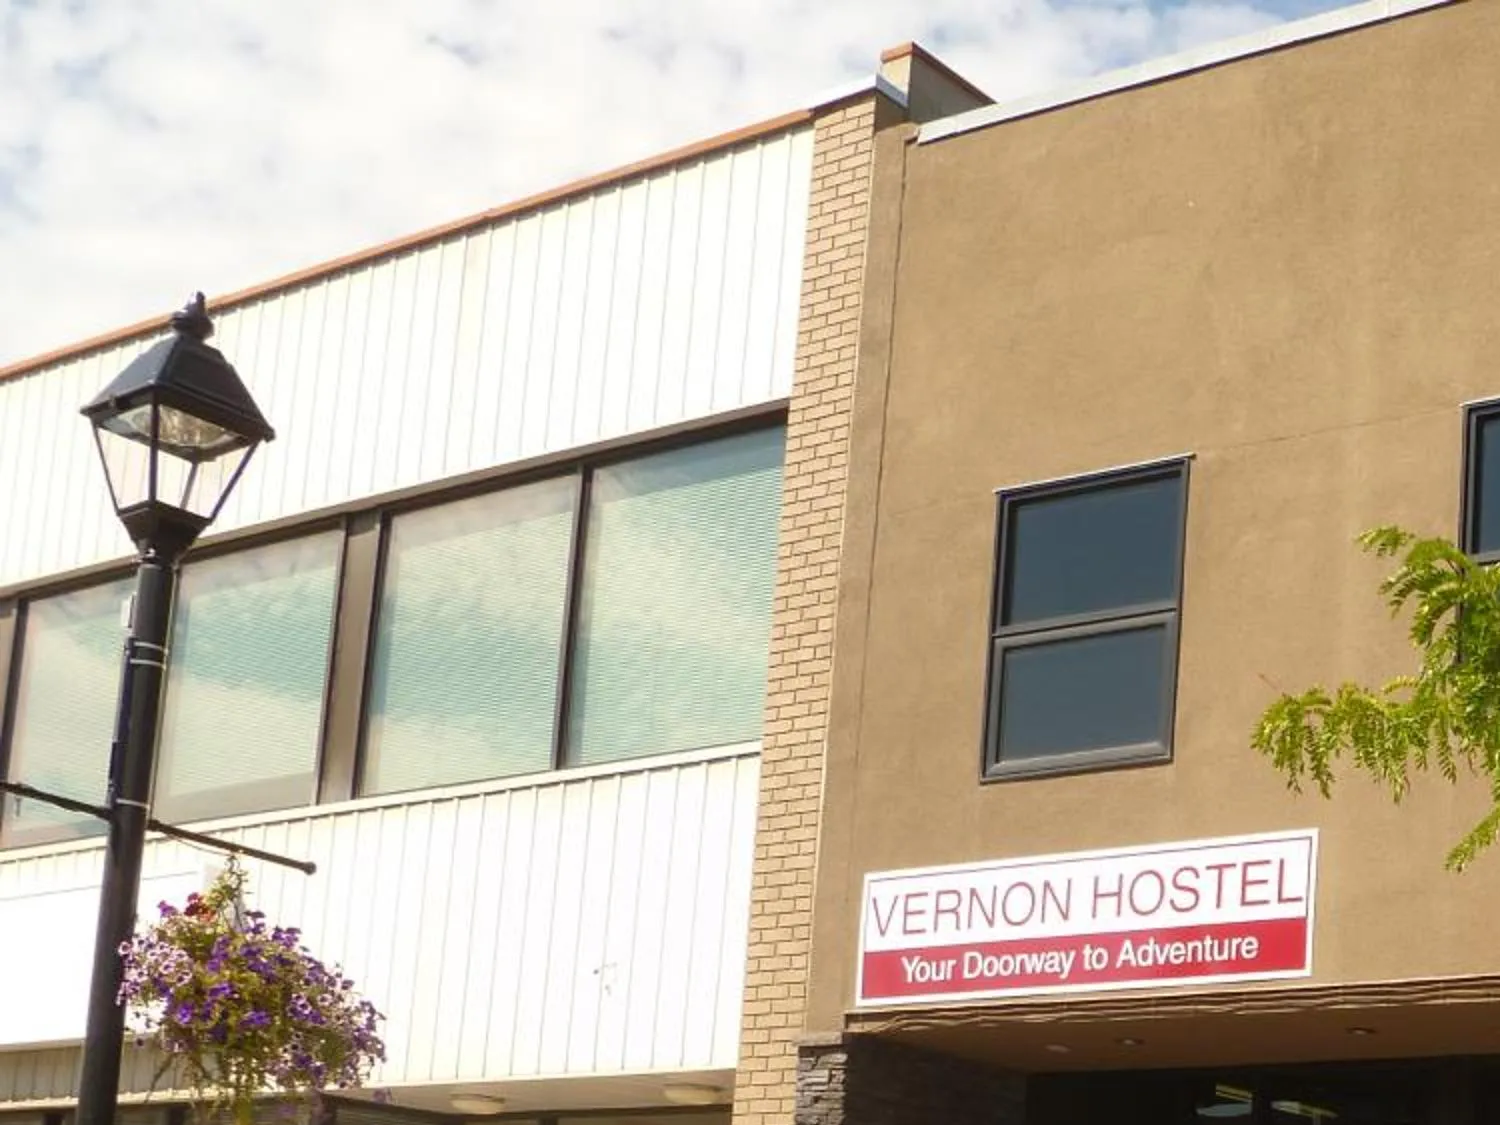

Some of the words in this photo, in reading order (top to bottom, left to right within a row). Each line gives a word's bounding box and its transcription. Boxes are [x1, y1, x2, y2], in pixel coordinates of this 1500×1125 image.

[872, 878, 1072, 938] VERNON
[1091, 858, 1304, 919] HOSTEL
[901, 955, 957, 984] Your
[963, 948, 1076, 984] Doorway
[1083, 944, 1109, 971] to
[1116, 933, 1259, 969] Adventure
